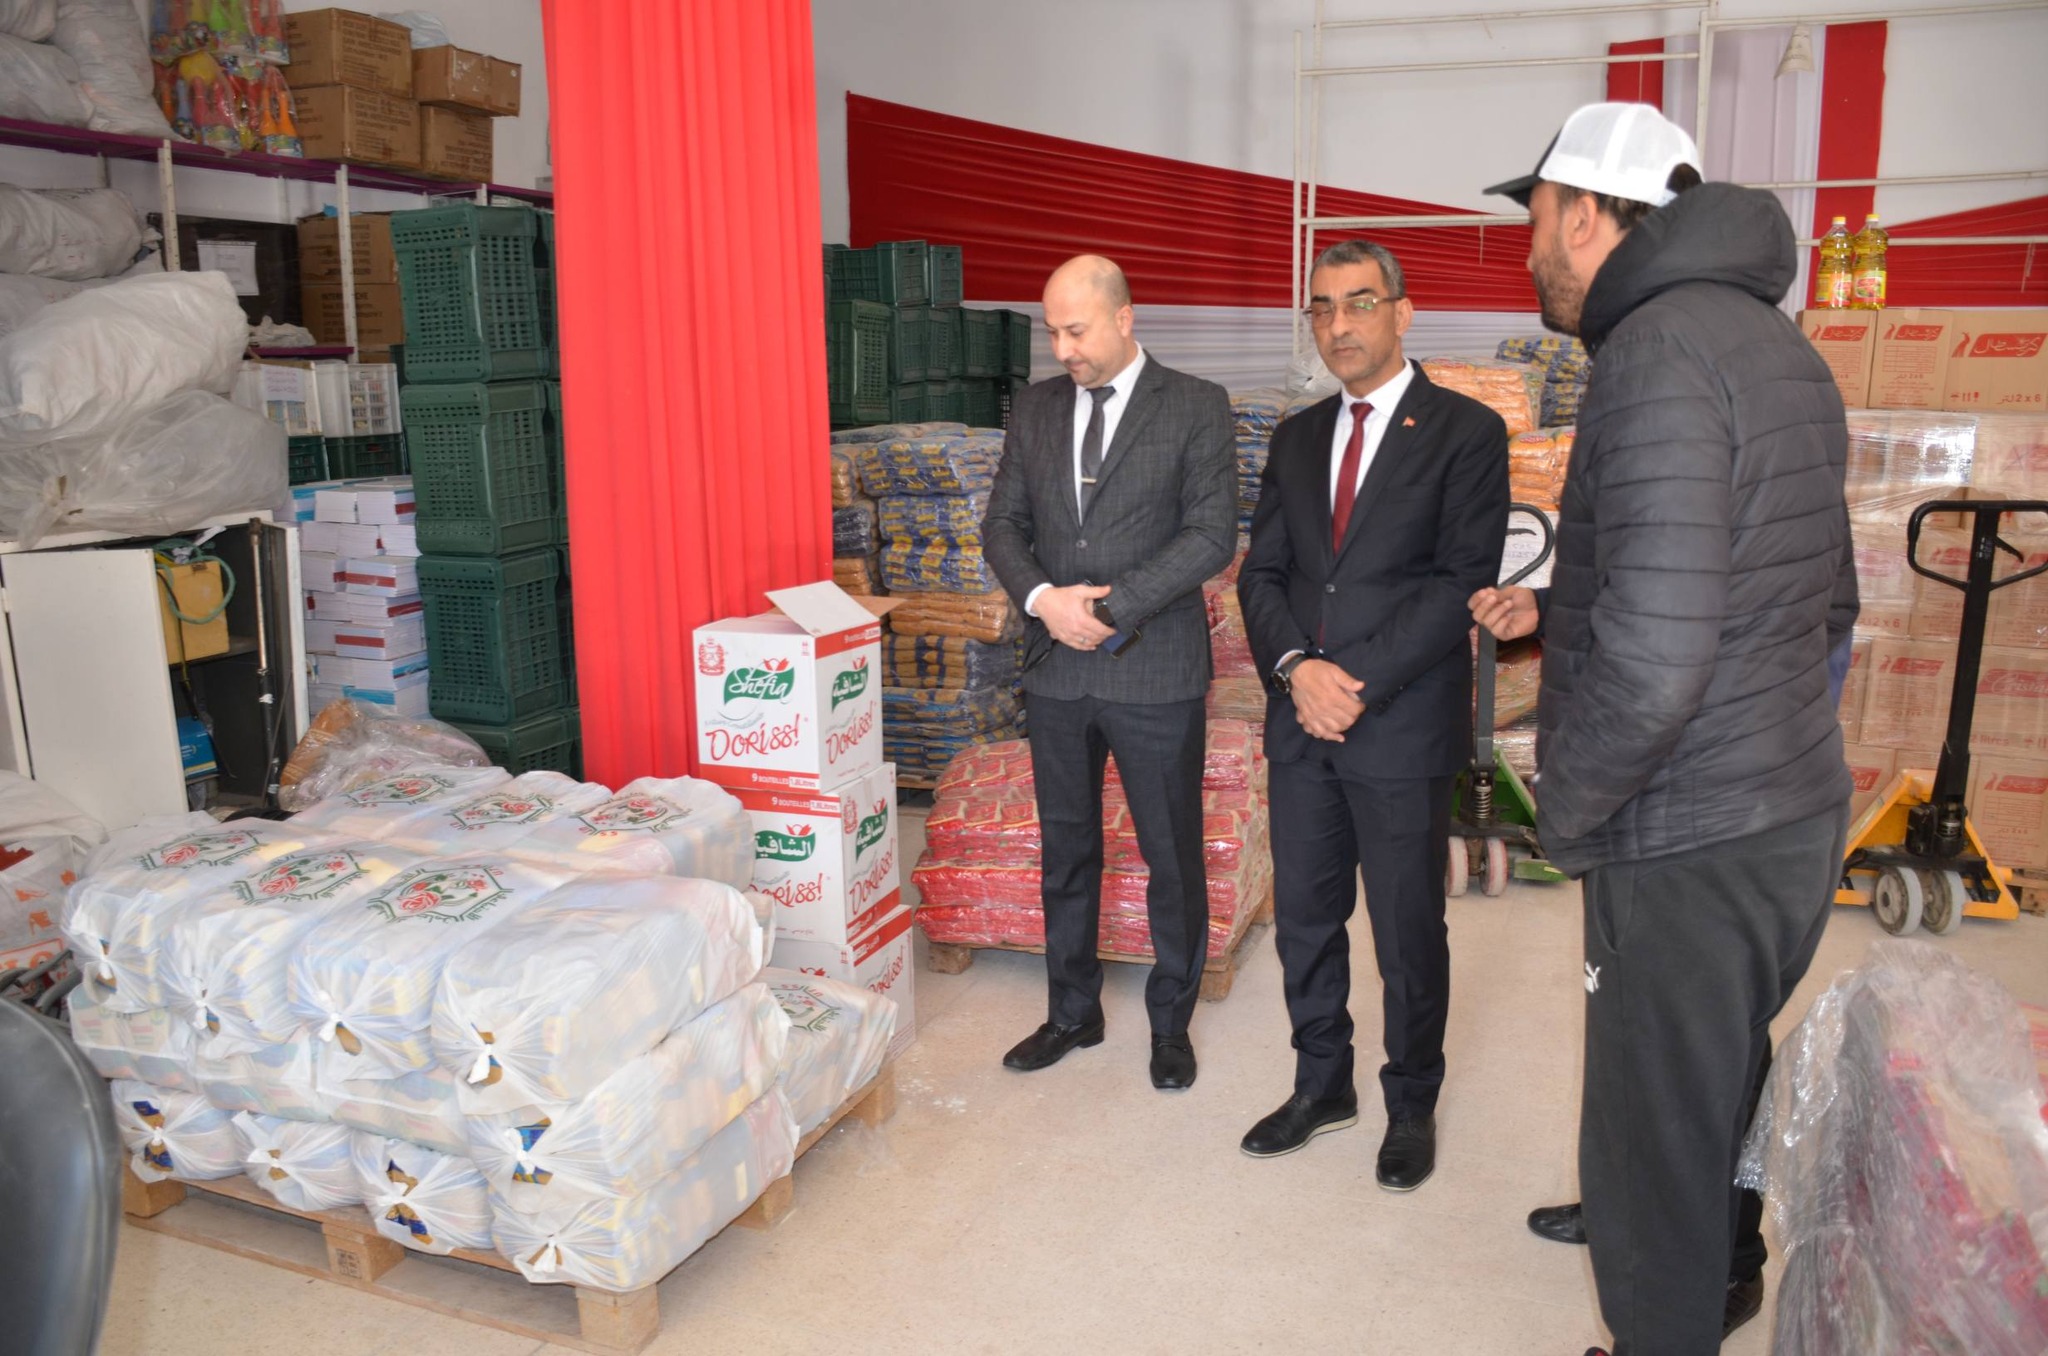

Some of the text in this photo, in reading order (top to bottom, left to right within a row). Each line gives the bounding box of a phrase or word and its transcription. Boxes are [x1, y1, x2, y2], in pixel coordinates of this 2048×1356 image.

[2016, 393, 2022, 402] 2
[751, 772, 758, 782] 9
[771, 796, 778, 806] 9
